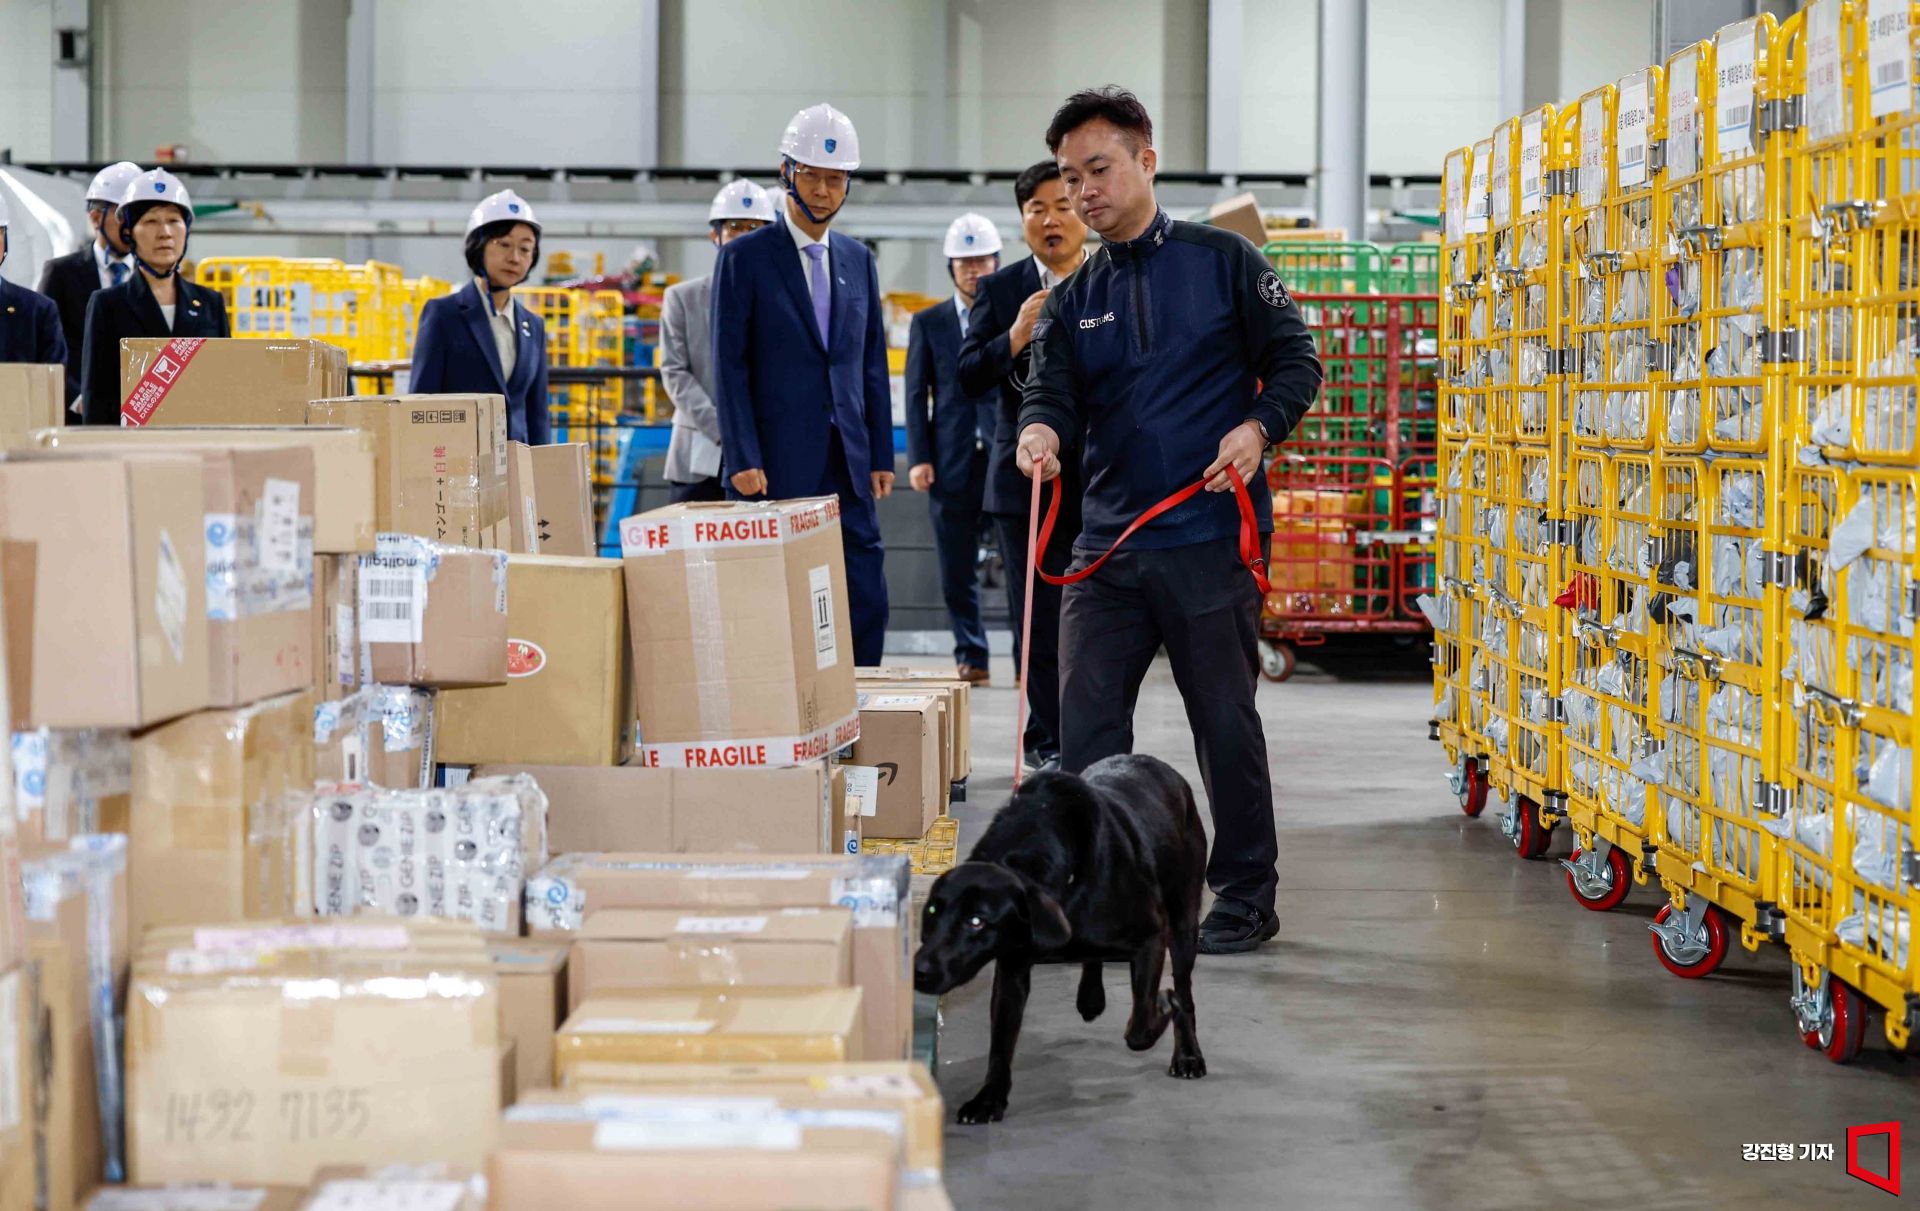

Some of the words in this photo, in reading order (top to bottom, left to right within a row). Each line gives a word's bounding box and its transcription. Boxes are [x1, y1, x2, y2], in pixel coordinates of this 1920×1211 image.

[1079, 311, 1115, 330] CUSTOMS
[132, 382, 158, 410] FRAGILE
[694, 518, 779, 543] FRAGILE
[789, 509, 820, 537] FRAGILE
[684, 744, 766, 768] FRAGILE
[329, 844, 344, 870] ZIP
[428, 855, 444, 879] ZIP
